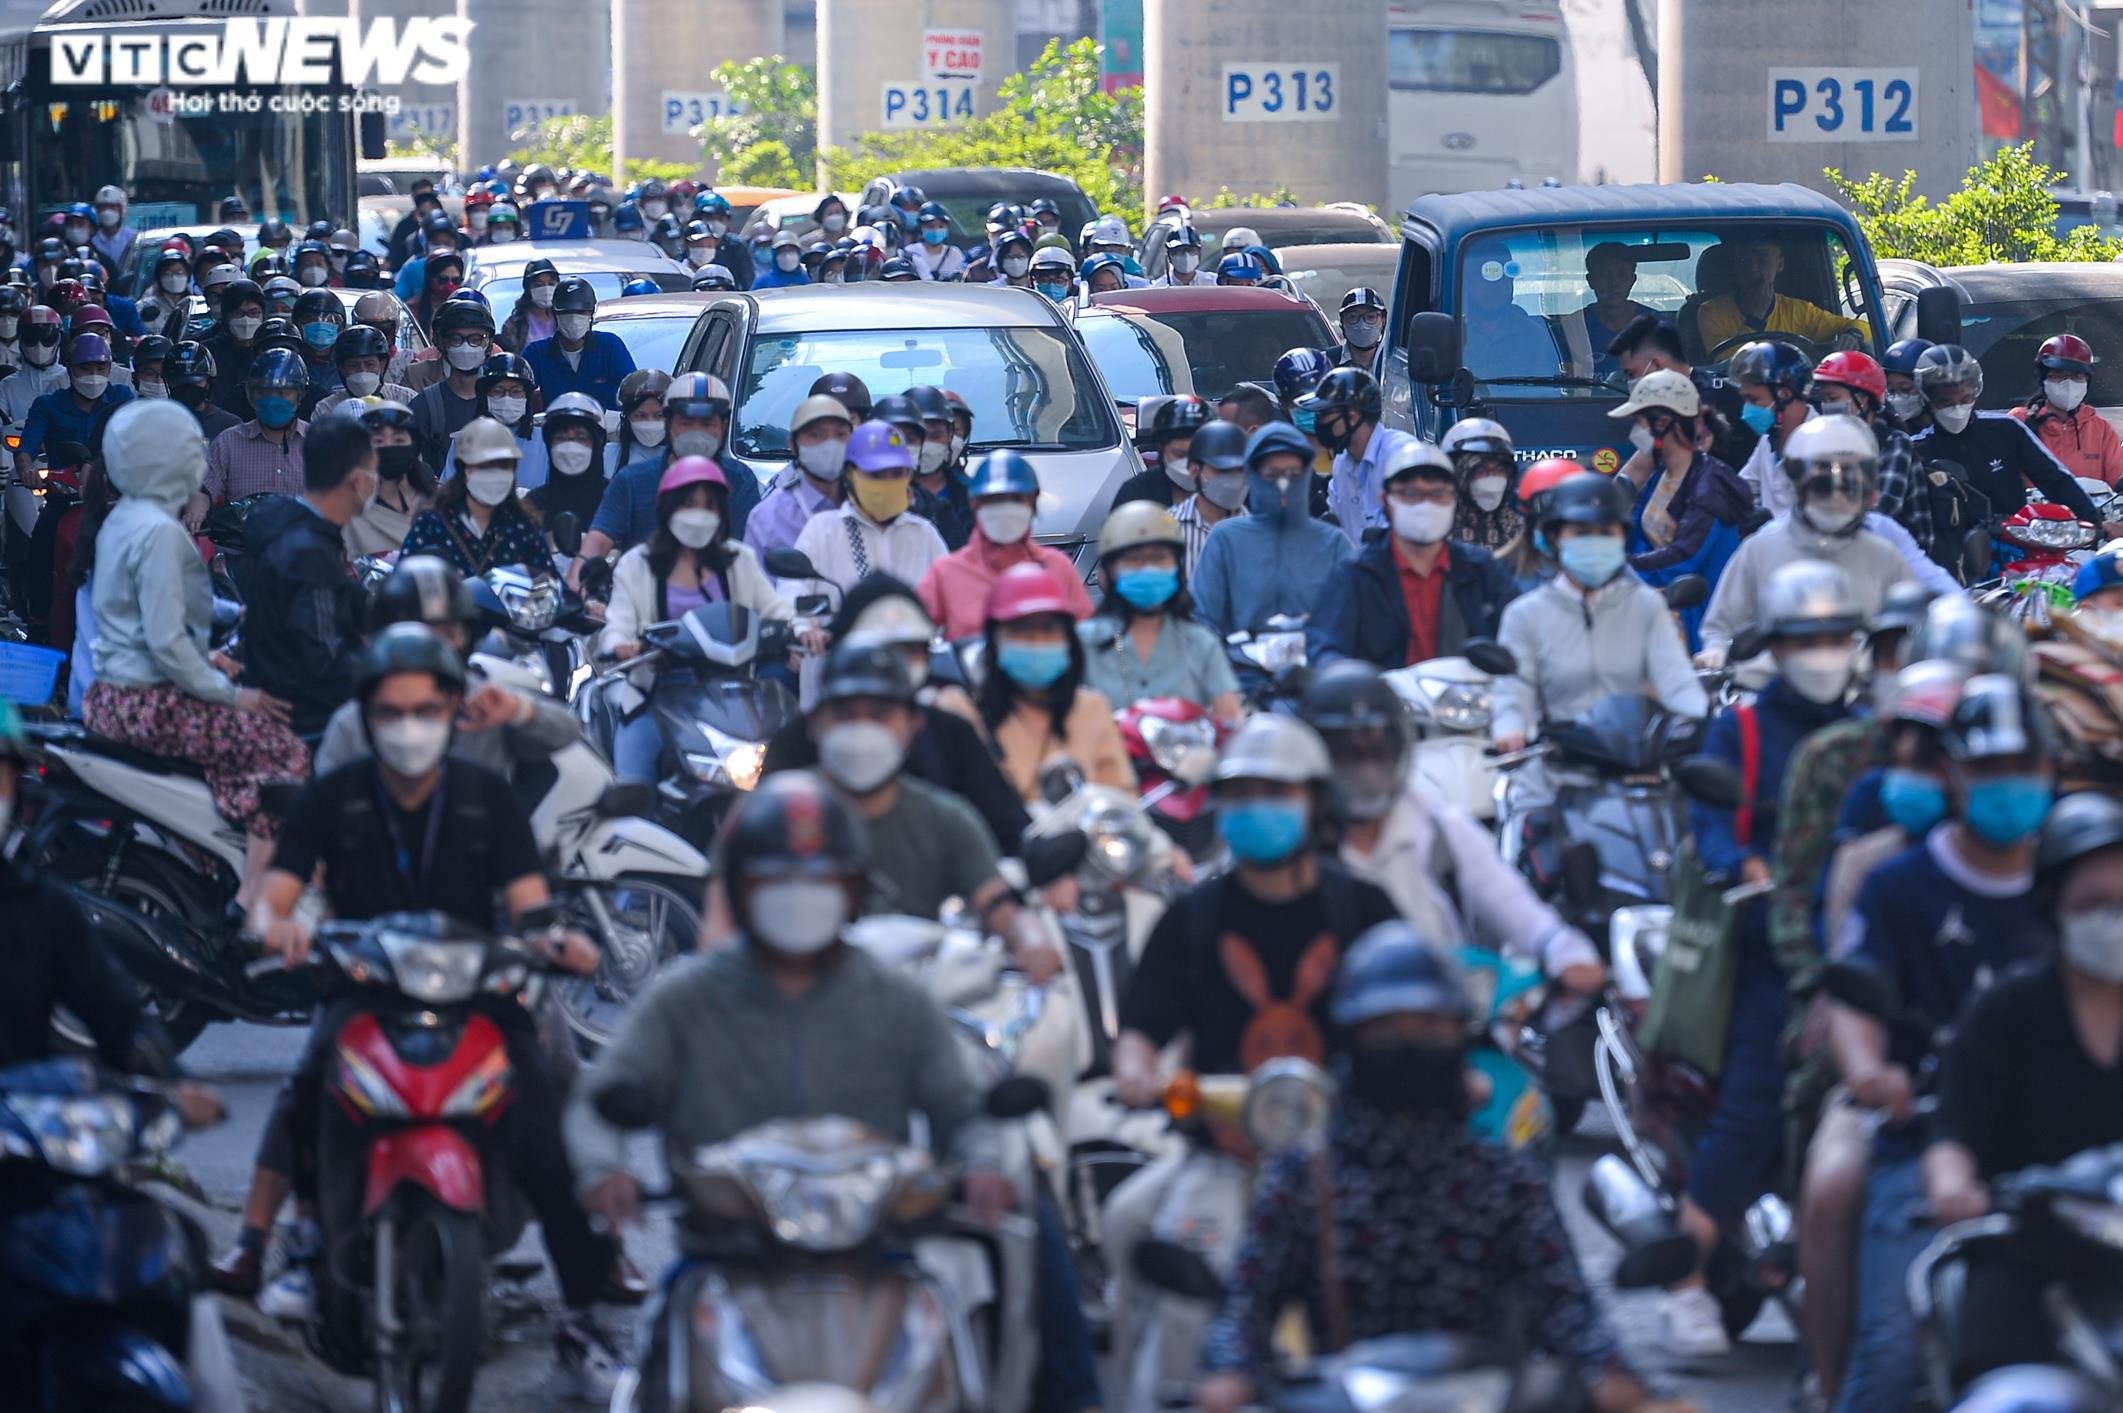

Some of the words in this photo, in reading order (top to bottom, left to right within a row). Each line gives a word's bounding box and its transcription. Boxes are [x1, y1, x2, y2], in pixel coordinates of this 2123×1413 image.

[886, 88, 975, 121] P314
[1227, 70, 1333, 113] P313
[1775, 77, 1912, 132] P312
[1513, 450, 1577, 462] THACO
